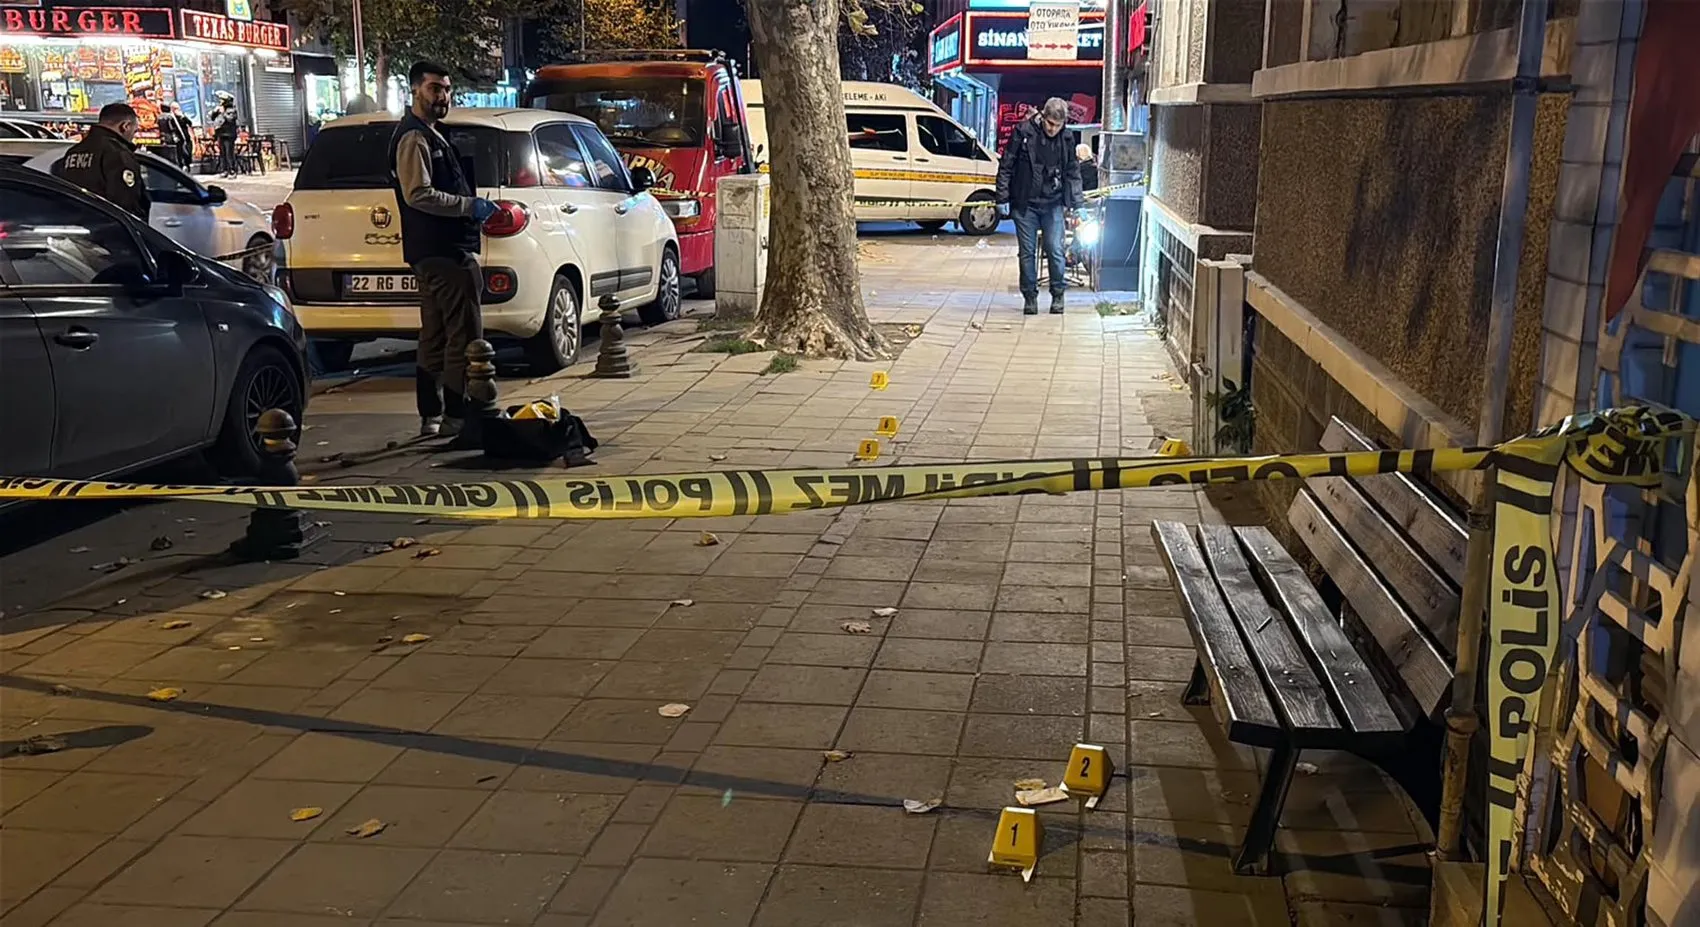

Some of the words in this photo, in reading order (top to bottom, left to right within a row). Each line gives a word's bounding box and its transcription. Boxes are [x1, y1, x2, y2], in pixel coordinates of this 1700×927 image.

[3, 9, 144, 33] BURGER
[192, 15, 235, 40] TEXAS
[237, 21, 281, 46] BURGER
[352, 276, 370, 290] 22
[376, 276, 394, 290] RG
[866, 443, 871, 453] 5
[1080, 757, 1090, 777] 2
[1010, 823, 1019, 846] 1
